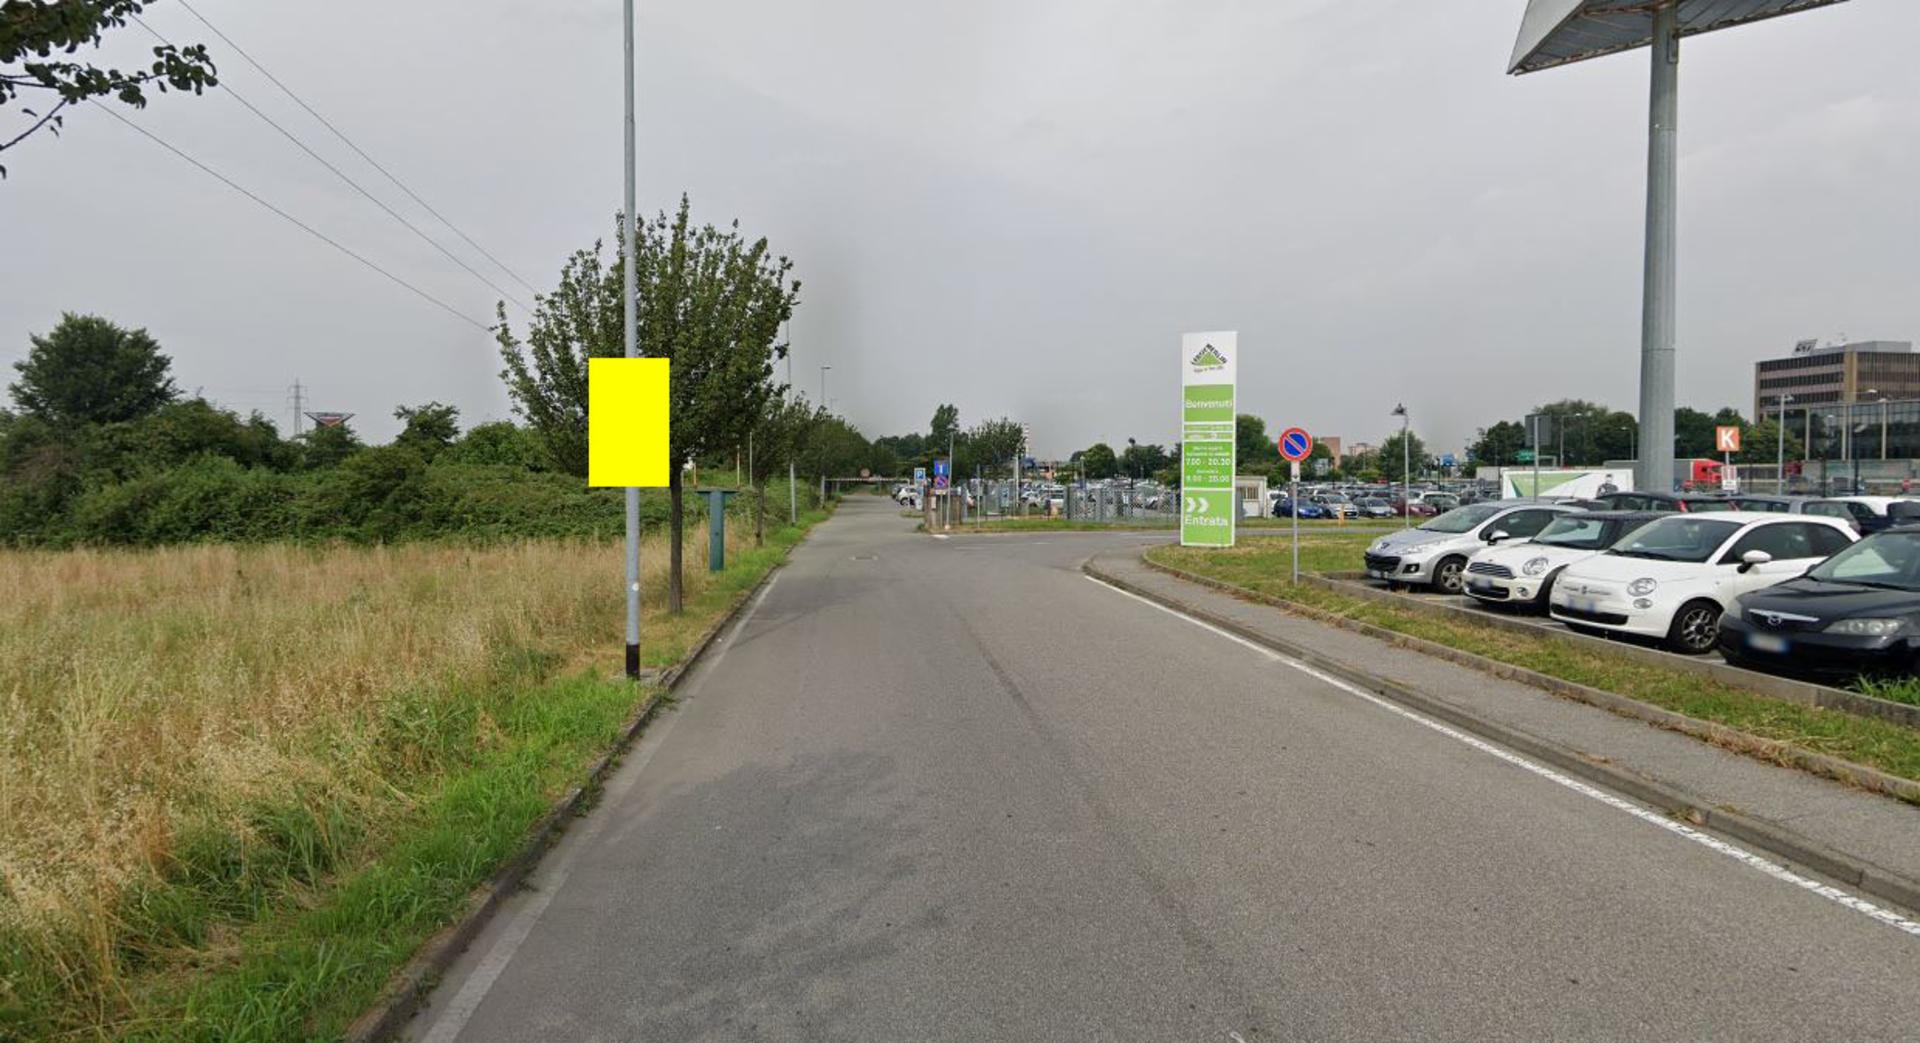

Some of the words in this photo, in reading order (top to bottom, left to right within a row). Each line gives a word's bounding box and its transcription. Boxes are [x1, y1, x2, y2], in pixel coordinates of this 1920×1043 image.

[1185, 399, 1233, 409] Benvenuti
[1721, 429, 1735, 448] K
[1185, 514, 1228, 526] Entrata
